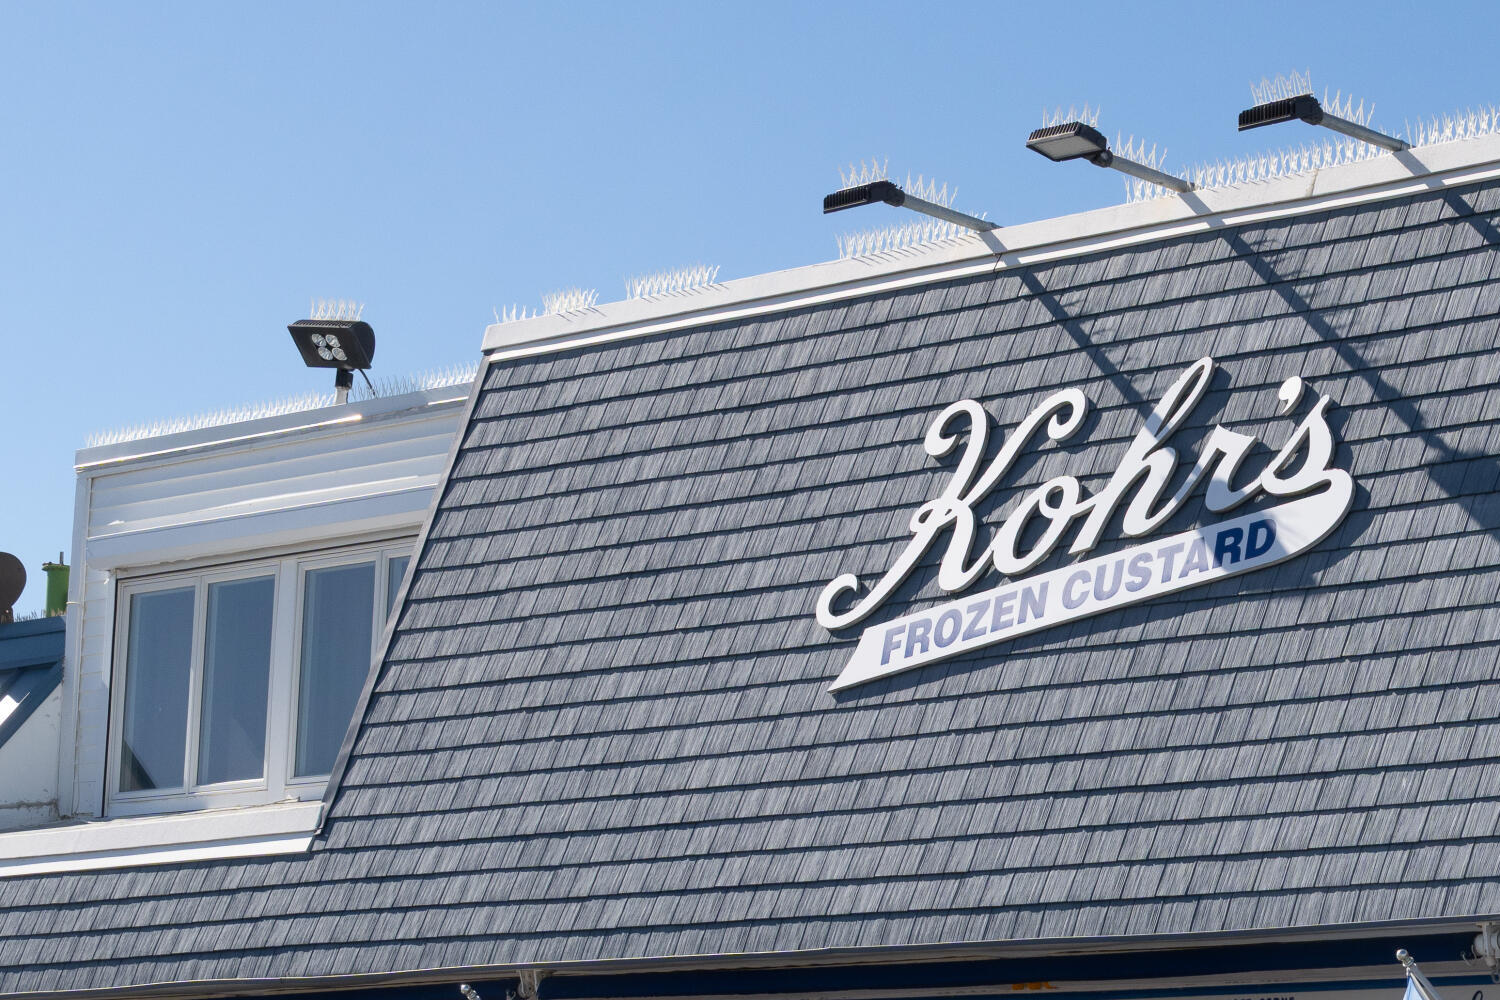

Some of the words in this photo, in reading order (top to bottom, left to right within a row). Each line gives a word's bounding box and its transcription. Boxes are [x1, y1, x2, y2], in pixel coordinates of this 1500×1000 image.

[816, 357, 1340, 631] Kohr's
[879, 581, 1051, 665] FROZEN
[1062, 519, 1278, 610] CUSTARD
